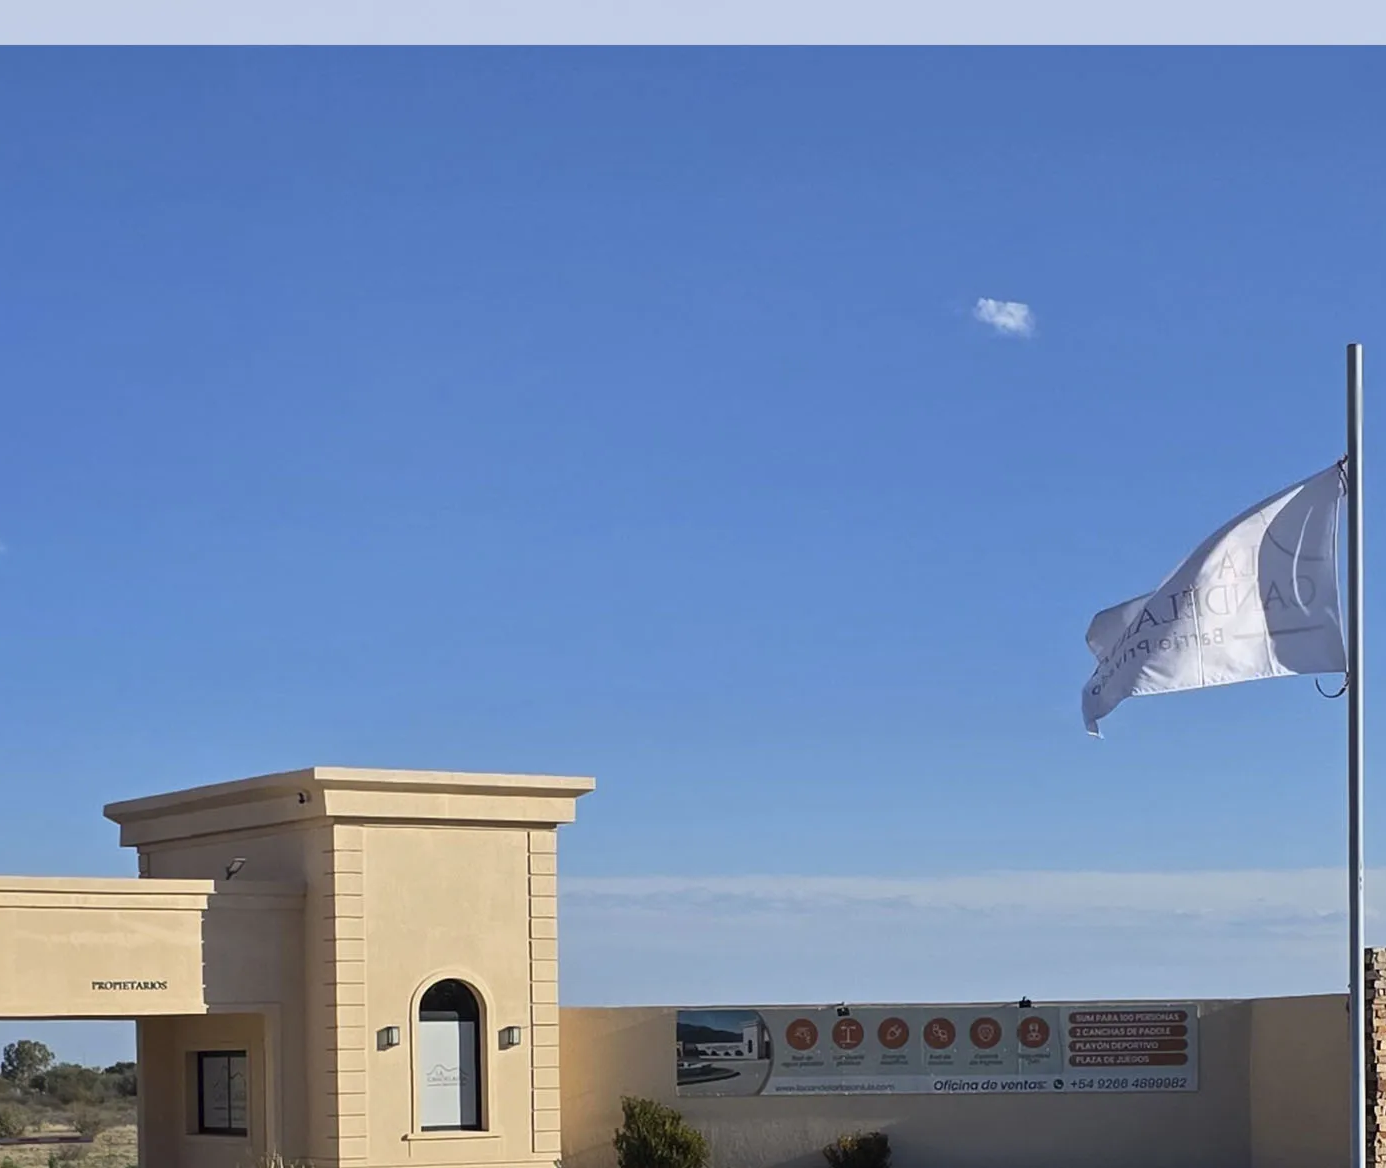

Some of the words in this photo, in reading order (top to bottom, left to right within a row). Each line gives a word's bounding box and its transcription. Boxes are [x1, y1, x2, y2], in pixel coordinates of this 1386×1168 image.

[91, 980, 169, 992] PROPIETARIOS
[1126, 1027, 1138, 1036] DE
[933, 1080, 979, 1092] Oficina
[981, 1079, 998, 1091] de
[1001, 1079, 1047, 1091] ventas:
[1070, 1079, 1094, 1090] +54
